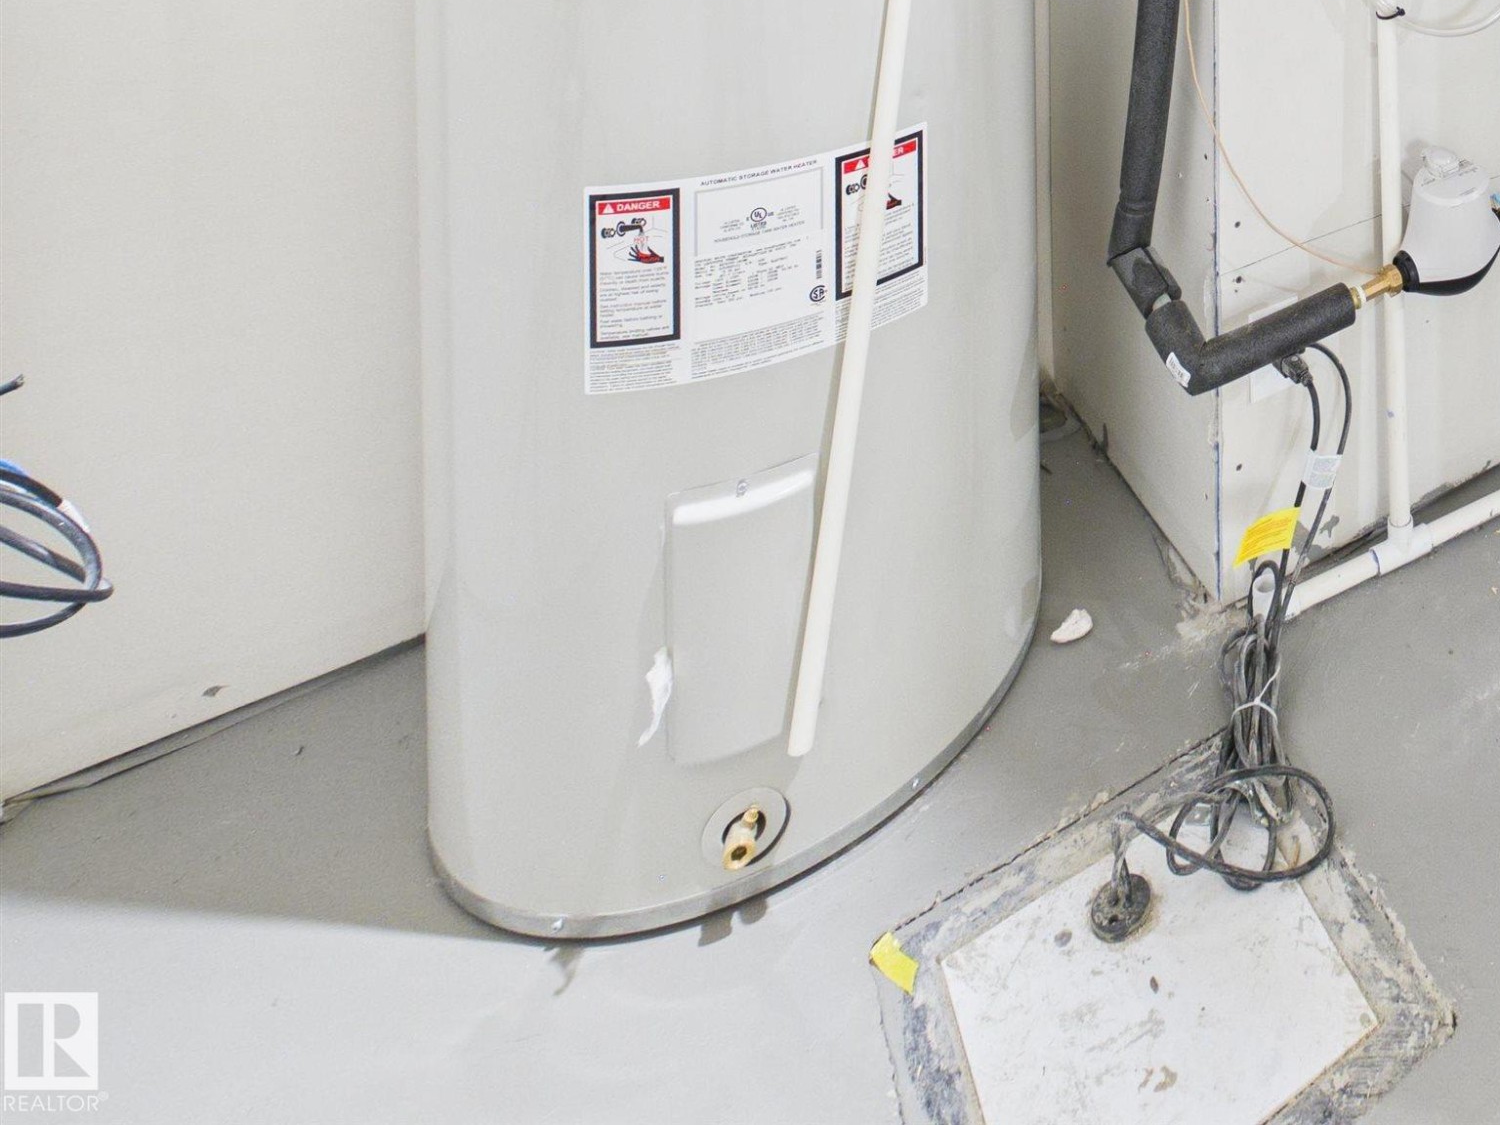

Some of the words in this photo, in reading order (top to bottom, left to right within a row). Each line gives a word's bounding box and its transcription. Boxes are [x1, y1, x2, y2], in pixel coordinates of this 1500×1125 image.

[700, 176, 738, 186] AUTOMATIC
[739, 170, 769, 180] STORAGE
[771, 165, 792, 173] WATER
[793, 160, 817, 169] HEATER
[616, 200, 660, 212] DANGER
[634, 236, 649, 244] HOT
